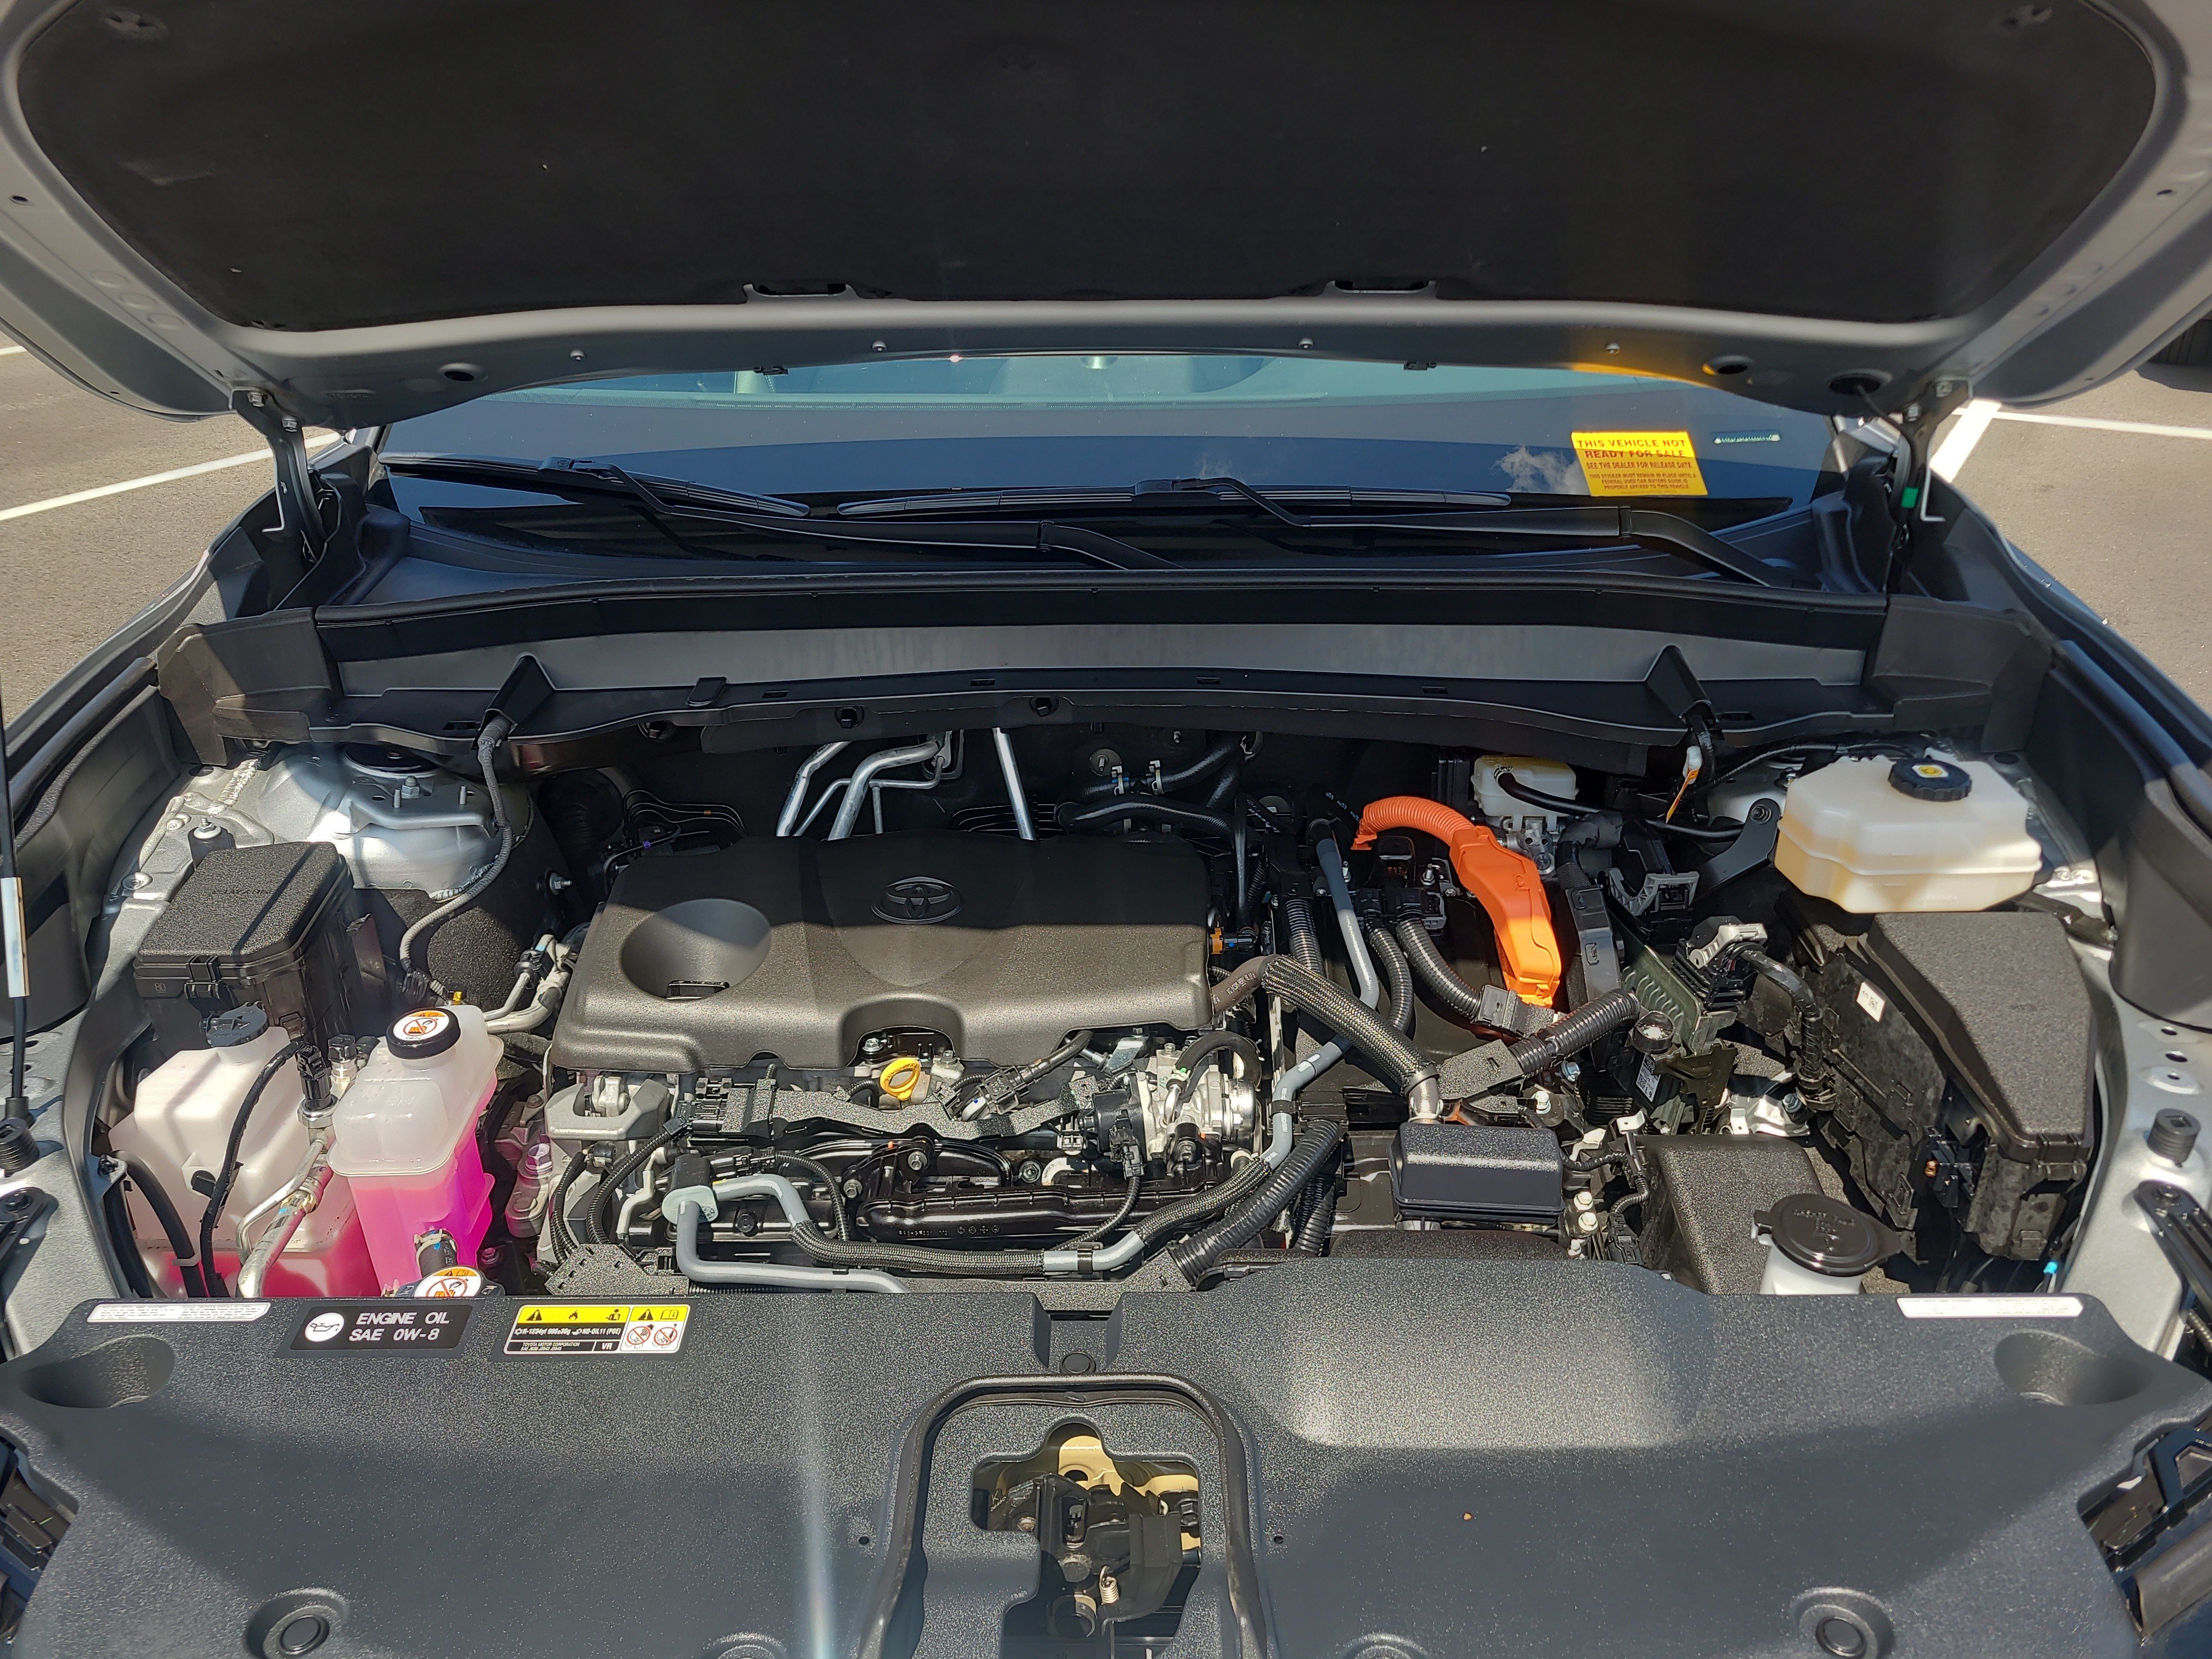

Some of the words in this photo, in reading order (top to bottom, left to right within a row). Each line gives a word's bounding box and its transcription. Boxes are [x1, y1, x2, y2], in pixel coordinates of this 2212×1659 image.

[356, 1312, 417, 1325] ENGINE
[425, 1312, 450, 1324] OIL
[349, 1328, 385, 1341] SAE
[393, 1328, 440, 1341] 0W-8
